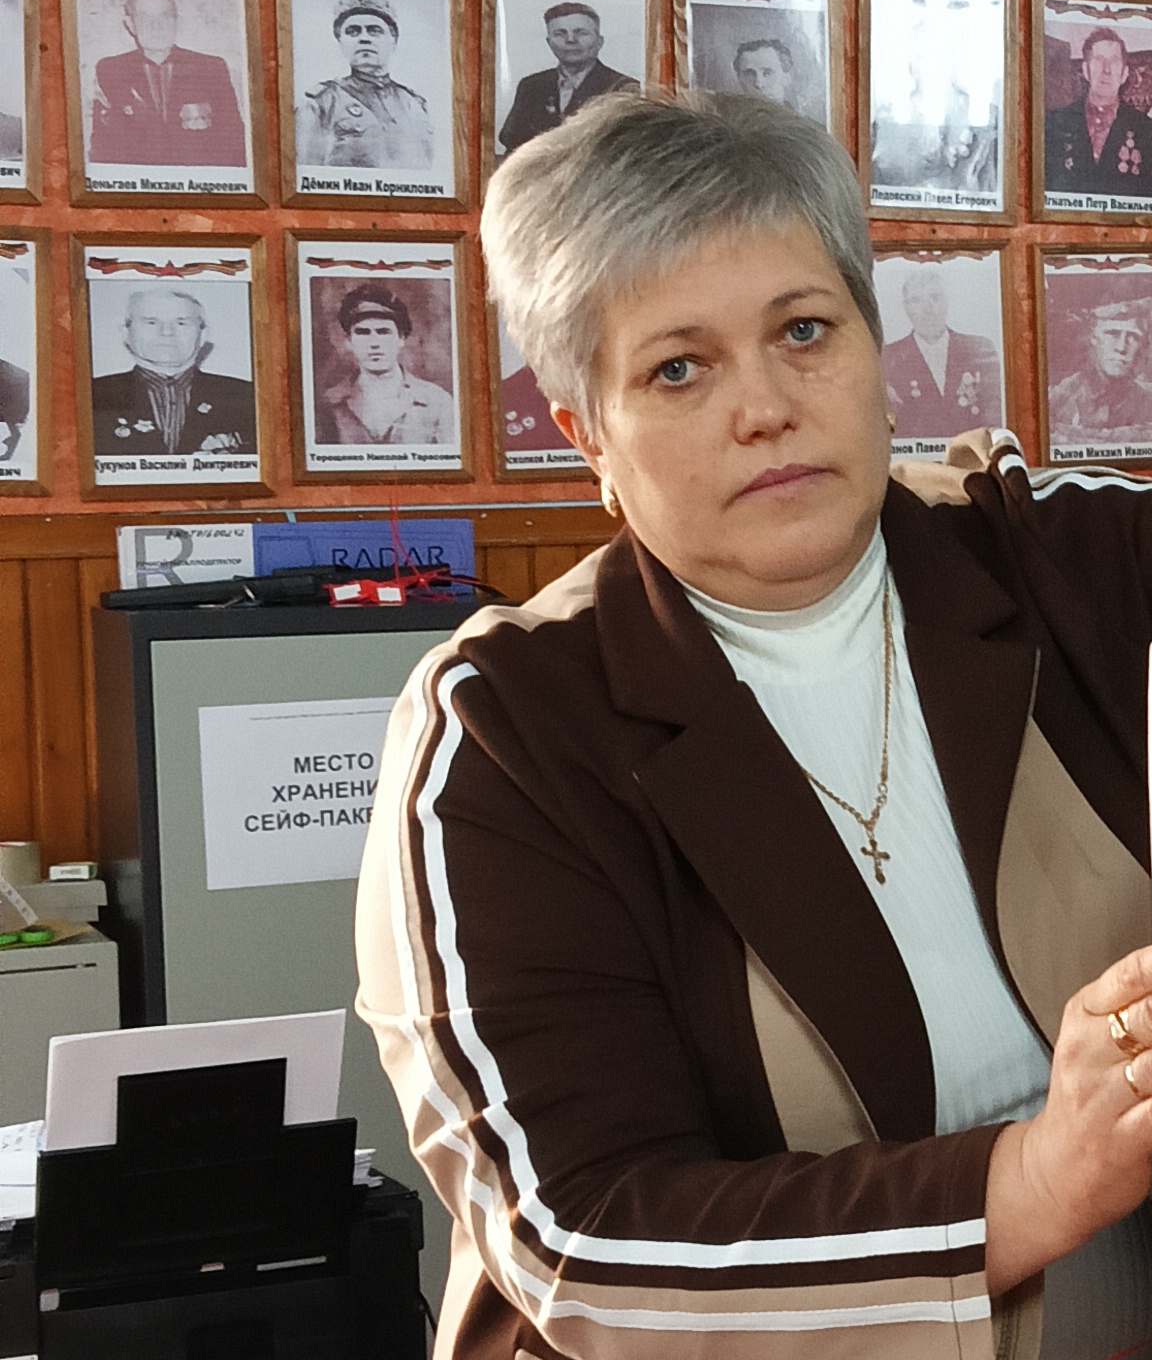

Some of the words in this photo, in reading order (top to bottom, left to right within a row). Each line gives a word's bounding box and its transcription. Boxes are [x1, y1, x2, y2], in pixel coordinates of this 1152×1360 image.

[140, 178, 185, 191] Михаил
[187, 179, 248, 193] Андреевич
[300, 176, 340, 191] Дёмин
[343, 178, 372, 192] Иван
[375, 179, 444, 196] Корнилович
[955, 193, 997, 207] Егорович
[1086, 197, 1108, 211] Петр
[915, 442, 946, 454] Павел
[1053, 448, 1083, 459] Рыков
[1086, 447, 1122, 458] Михаил
[139, 458, 187, 470] Василий
[192, 458, 258, 472] Дмитриевич
[332, 545, 445, 570] RADAR
[293, 751, 375, 774] МЕСТО
[271, 780, 379, 804] ХРАНЕНИ
[244, 804, 375, 833] СЕЙФ-ПАКЕ
